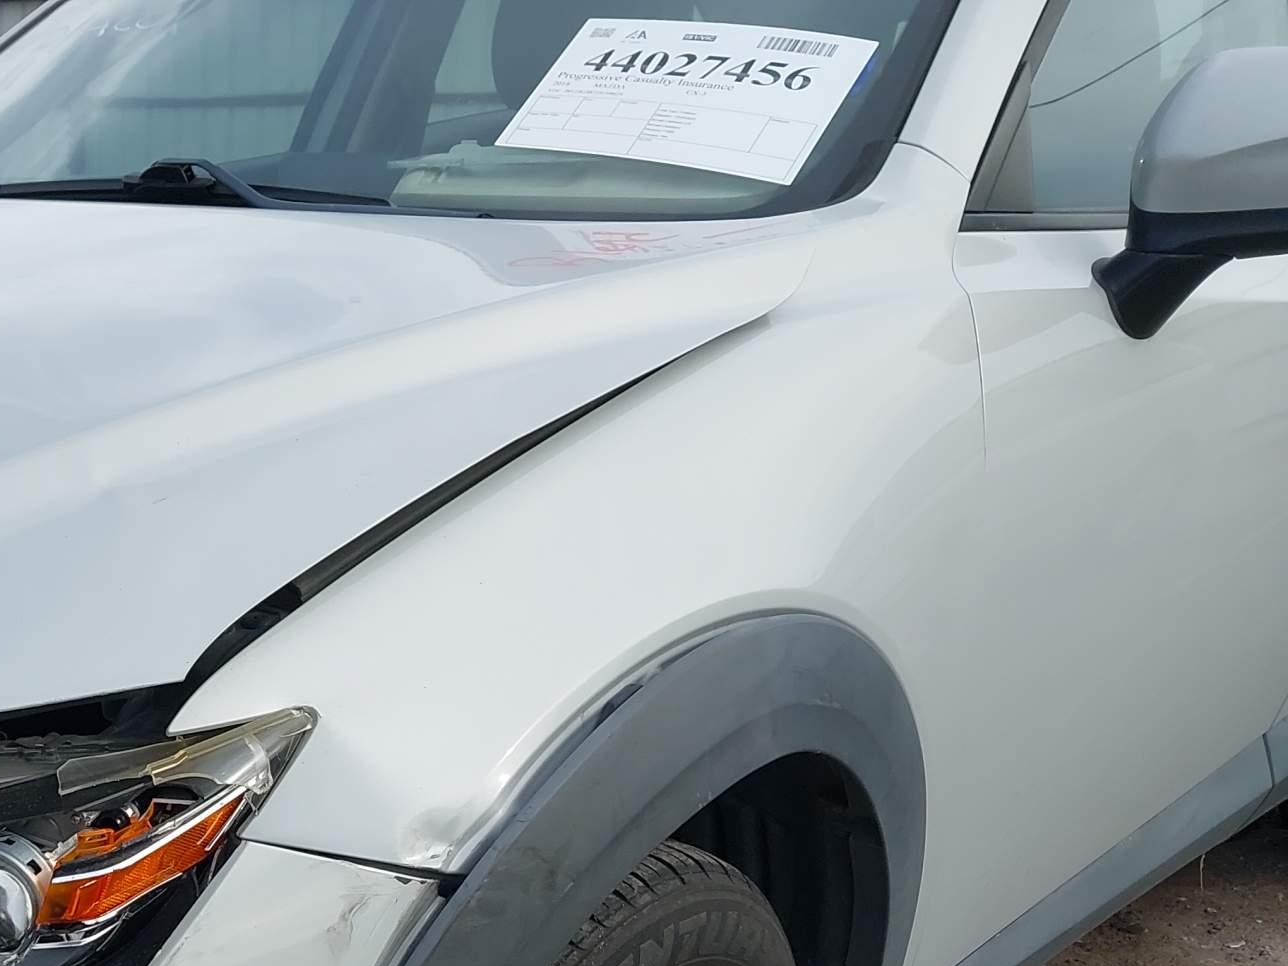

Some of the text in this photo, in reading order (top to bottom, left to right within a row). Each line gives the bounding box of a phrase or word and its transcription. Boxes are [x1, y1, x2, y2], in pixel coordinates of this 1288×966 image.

[557, 71, 735, 91] Progressive Casualty Insurance
[583, 48, 822, 91] 44027456
